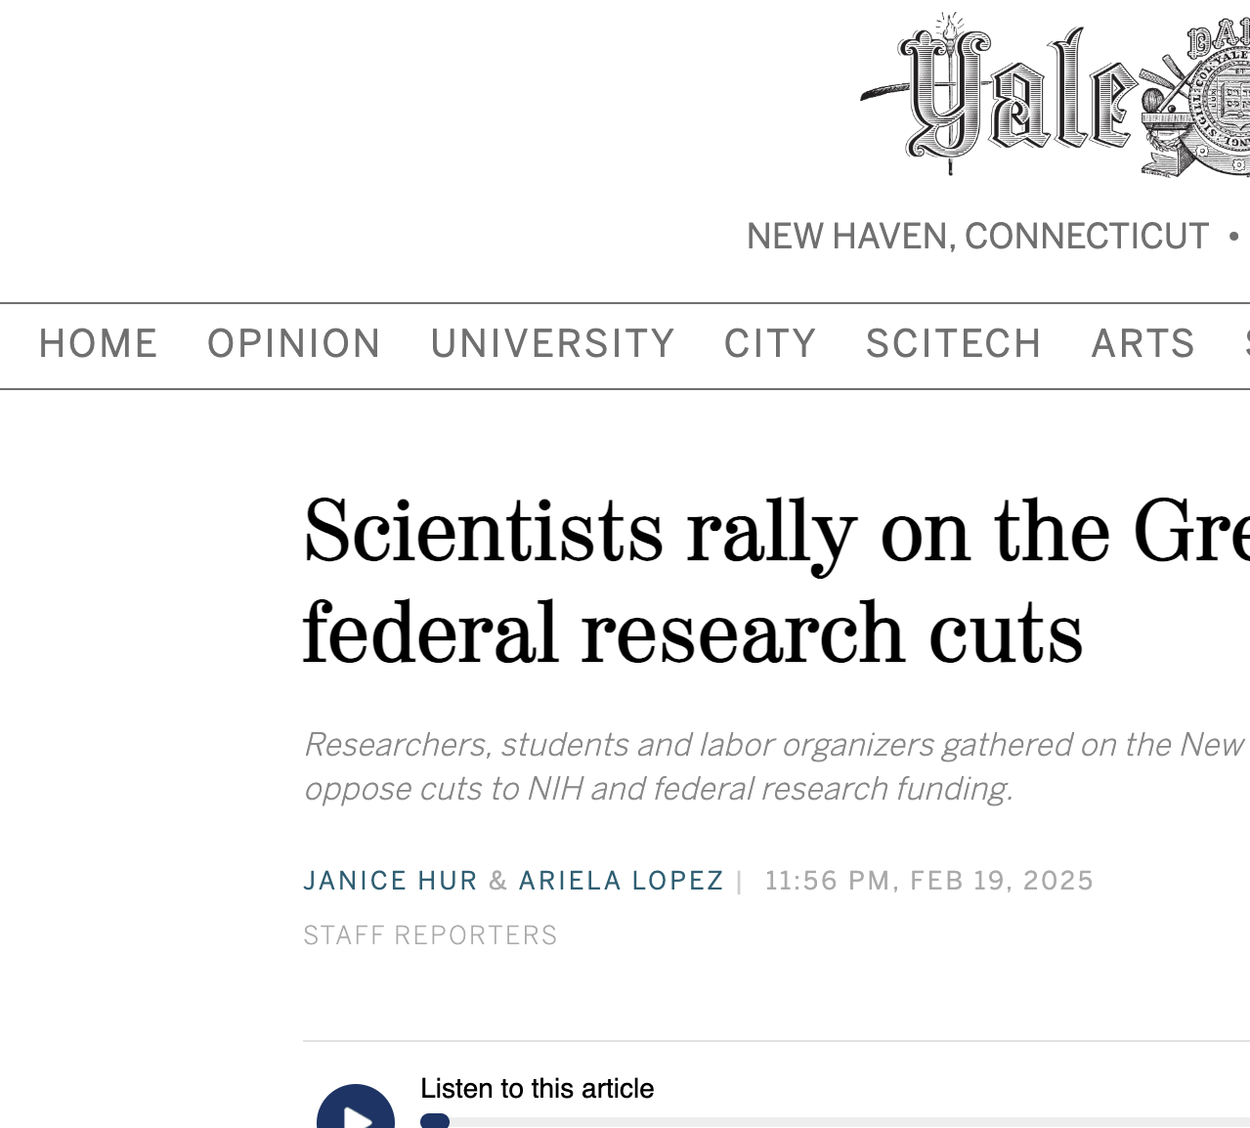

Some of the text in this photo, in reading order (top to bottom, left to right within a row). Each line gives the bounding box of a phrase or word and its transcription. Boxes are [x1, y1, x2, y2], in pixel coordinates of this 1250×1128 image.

[898, 27, 1139, 158] Yale
[749, 222, 824, 249] NEW
[835, 222, 955, 252] HAVEN,
[966, 222, 1209, 249] CONNECTICUT
[41, 328, 156, 358] HOME
[208, 328, 377, 358] OPINION
[433, 328, 674, 358] UNIVERSITY
[725, 328, 815, 358] CITY
[867, 328, 1038, 358] SCITECH
[1092, 328, 1193, 358] ARTS
[307, 497, 662, 562] Scientists
[687, 497, 858, 579] rally
[882, 516, 971, 562] on
[994, 497, 1109, 561] the
[303, 598, 1082, 663] federal research cuts
[306, 732, 491, 759] Researchers,
[502, 732, 629, 756] students
[638, 732, 694, 756] and
[701, 732, 777, 756] labor
[784, 732, 935, 762] organizers
[941, 732, 1074, 762] gathered
[1082, 738, 1116, 756] on
[1127, 732, 1171, 756] the
[1181, 732, 1245, 756] New
[306, 776, 1012, 806] oppose cuts to NIH and federal research funding.
[303, 870, 1092, 892] JANICE HUR & ARIELA LOPEZ 11:56 PM, FEB 19, 2025
[304, 925, 556, 945] STAFF REPORTERS
[422, 1077, 654, 1099] Listen to this article
